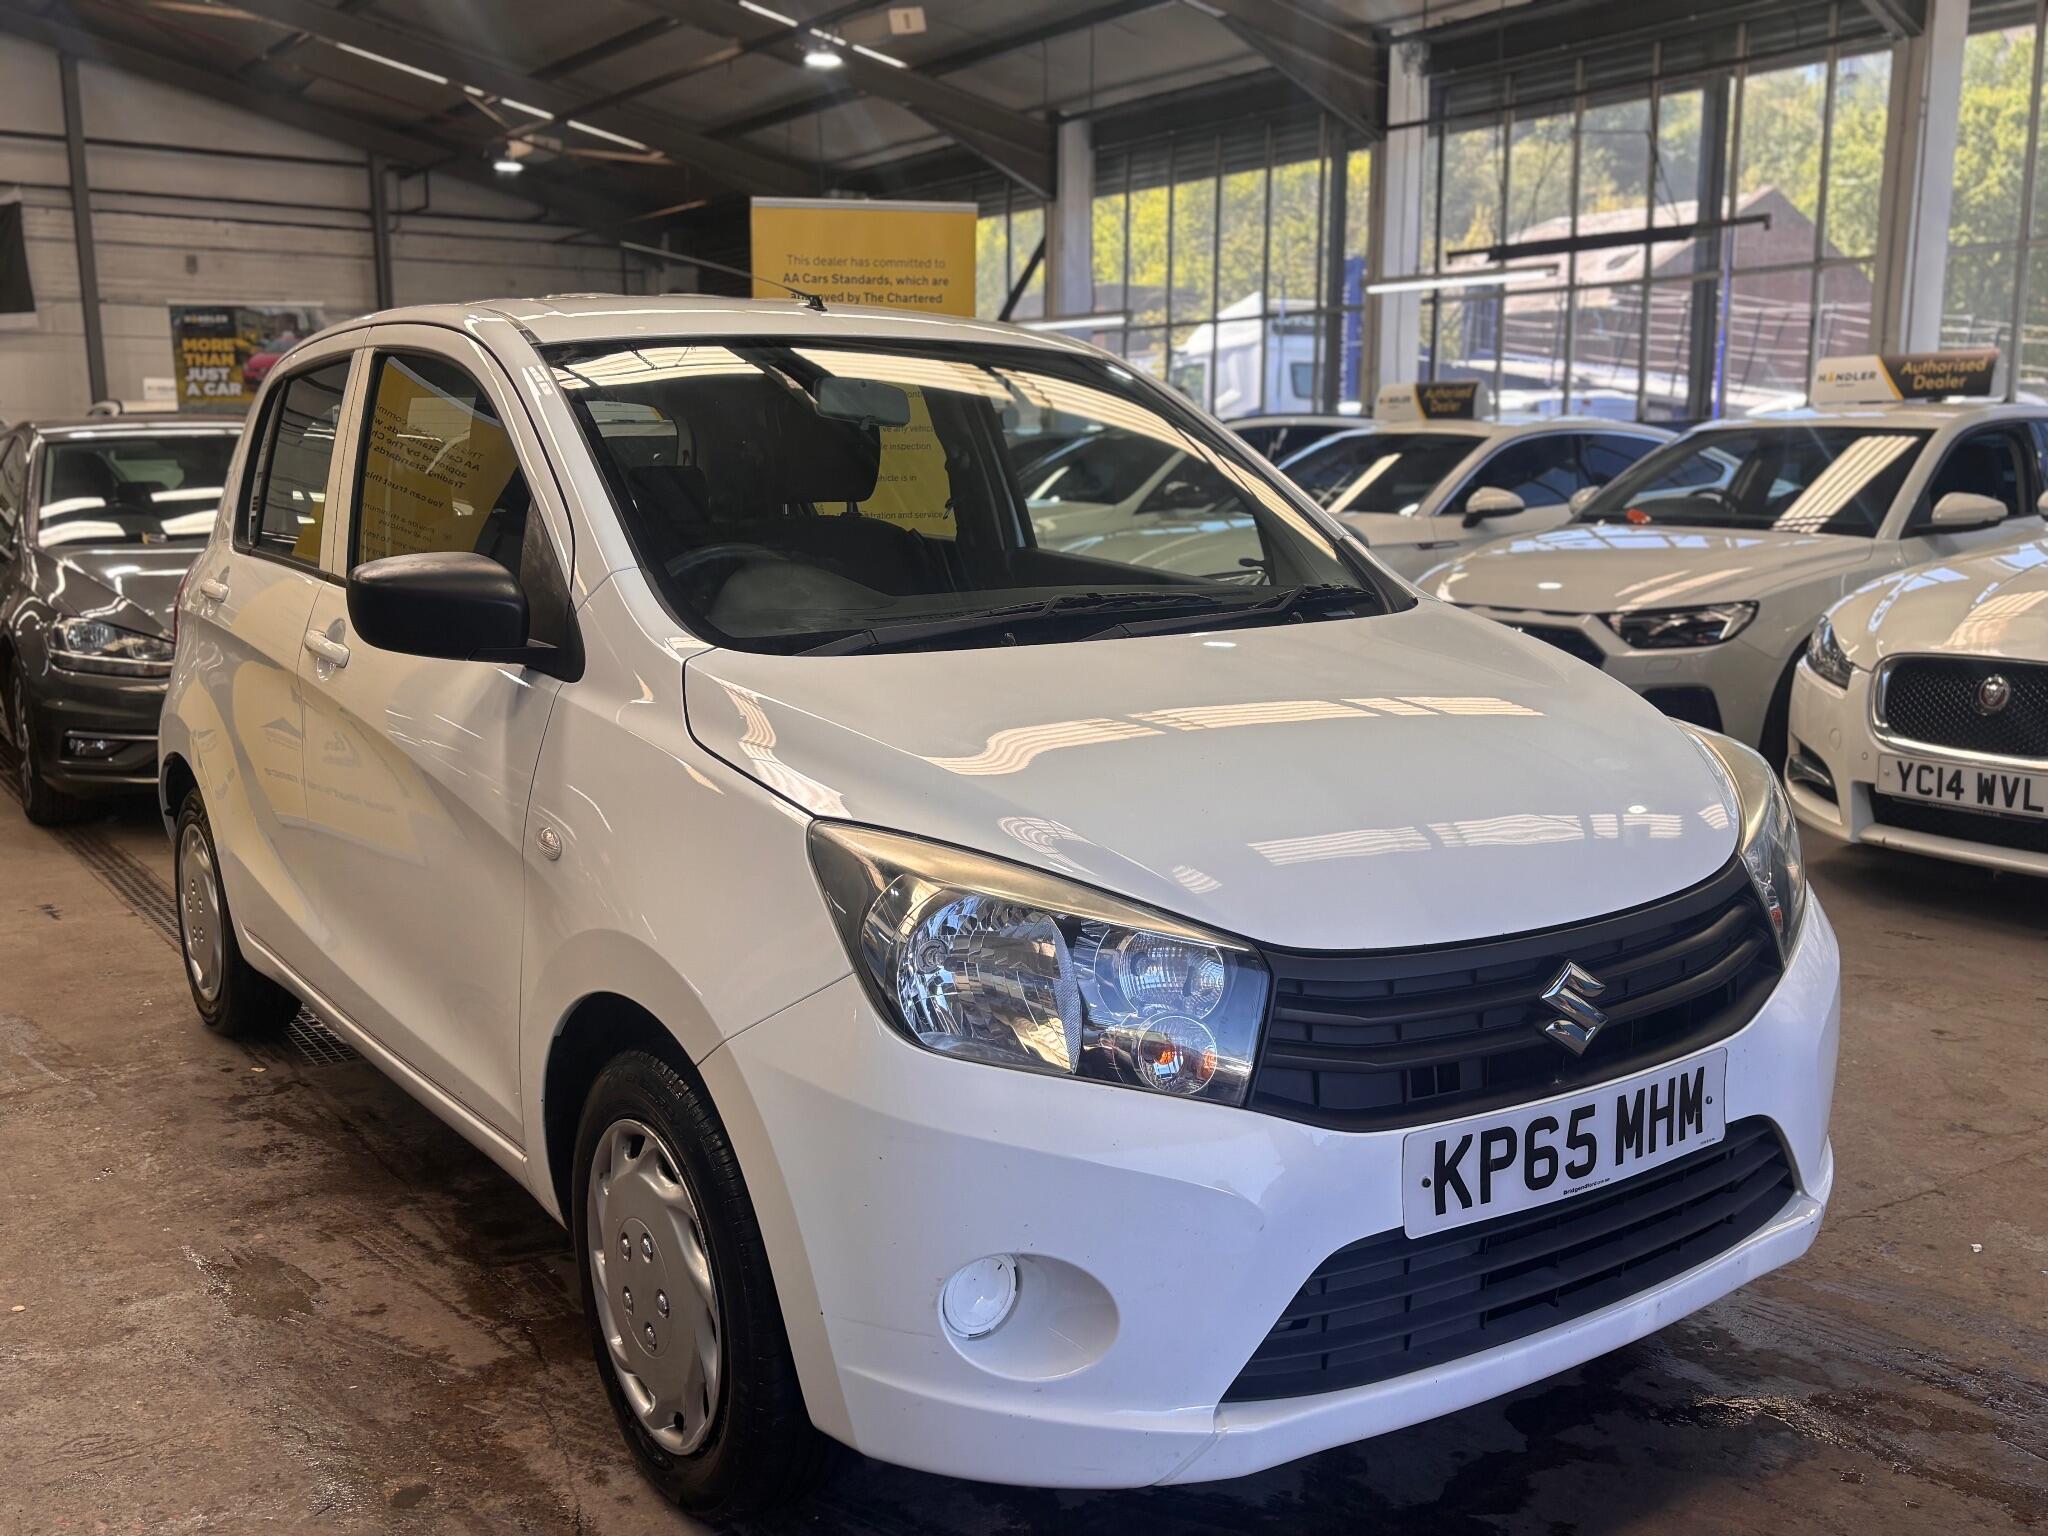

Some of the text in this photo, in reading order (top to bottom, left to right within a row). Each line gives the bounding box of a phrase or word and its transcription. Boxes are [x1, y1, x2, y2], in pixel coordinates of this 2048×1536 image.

[786, 254, 946, 269] This dealer has committed to
[783, 273, 949, 287] AA Cars Standards, which are
[846, 292, 861, 304] by
[863, 292, 885, 303] The
[886, 293, 943, 304] Chartered
[182, 338, 235, 351] MORE
[183, 353, 236, 366] THAN
[1901, 356, 1988, 375] Authorised
[186, 368, 230, 382] JUST
[186, 382, 202, 397] A
[204, 382, 242, 397] CAR
[1913, 375, 1968, 391] Dealer
[897, 511, 913, 520] and
[913, 511, 943, 519] service
[1896, 760, 2044, 813] YC14 WVL
[1432, 1065, 1705, 1216] KP65 MHM
